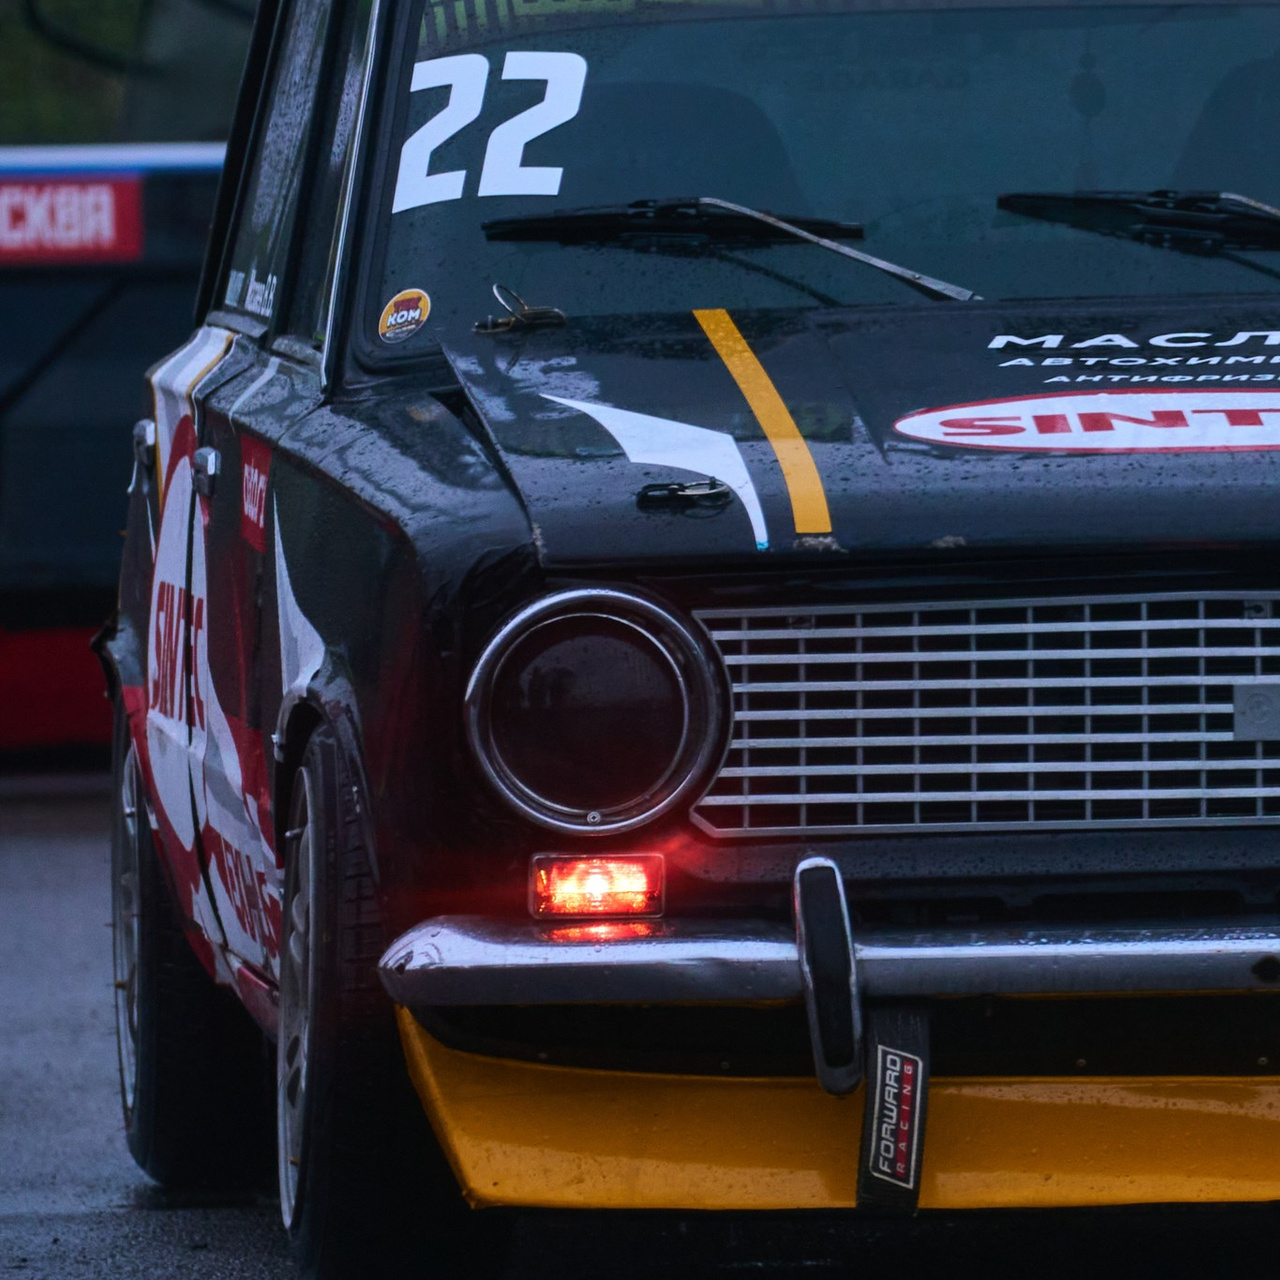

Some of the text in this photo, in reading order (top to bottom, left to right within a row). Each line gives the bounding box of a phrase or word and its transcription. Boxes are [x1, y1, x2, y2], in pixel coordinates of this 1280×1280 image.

[392, 51, 588, 213] 22
[880, 1054, 902, 1173] FORWARD
[896, 1063, 914, 1174] RACING
